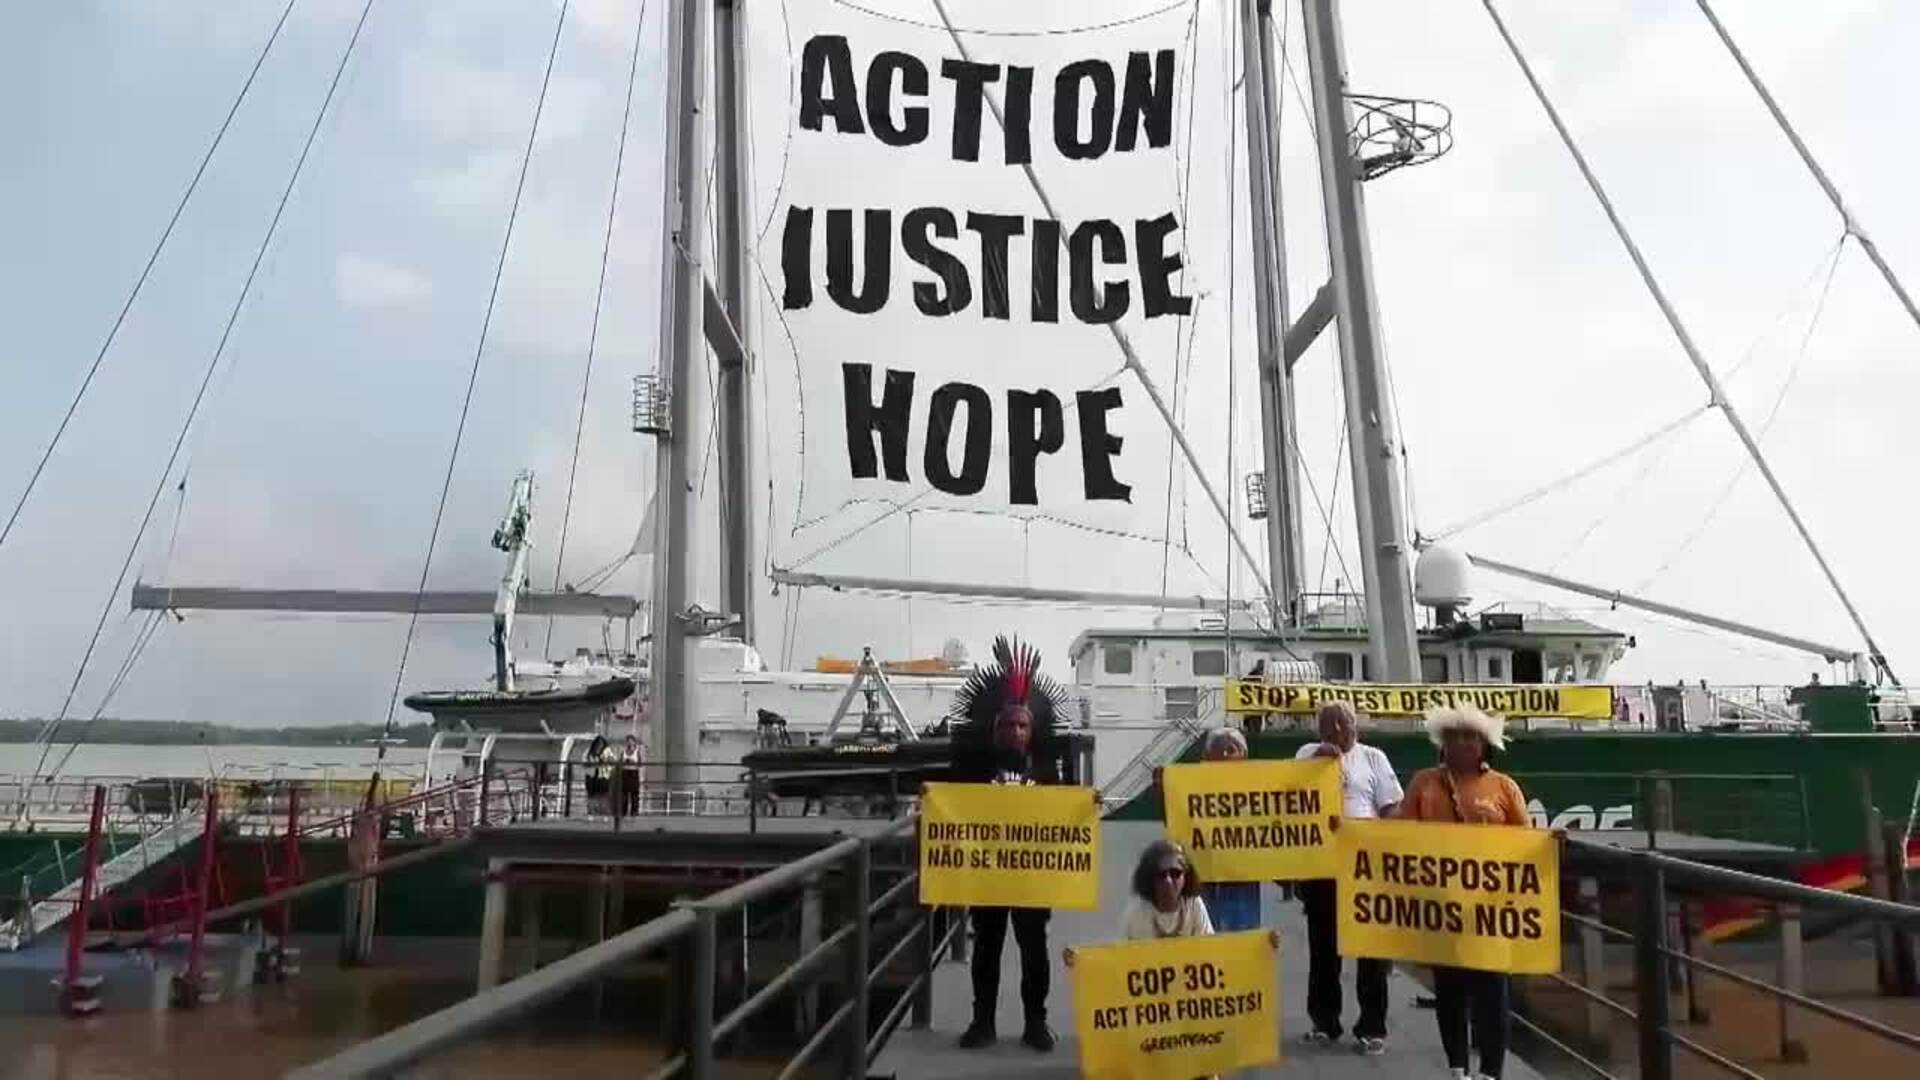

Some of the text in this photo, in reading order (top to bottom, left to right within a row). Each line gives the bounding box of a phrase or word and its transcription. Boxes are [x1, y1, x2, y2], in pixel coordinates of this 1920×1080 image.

[800, 35, 1175, 165] ACTION
[842, 362, 1133, 505] HOPE
[1240, 684, 1299, 708] STOP
[1188, 789, 1321, 818] RESPEITEM
[928, 822, 1091, 844] DIREITOS INDÍGENAS
[1192, 820, 1323, 850] A AMAZÔNIA
[928, 844, 1091, 871] NÃO SE NEGOCIAM
[1354, 850, 1540, 894] A RESPOSTA
[1353, 892, 1542, 940] SOMOS NÓS
[1127, 962, 1225, 997] COP 30:
[1094, 990, 1262, 1030] ACT FOR FORESTS!
